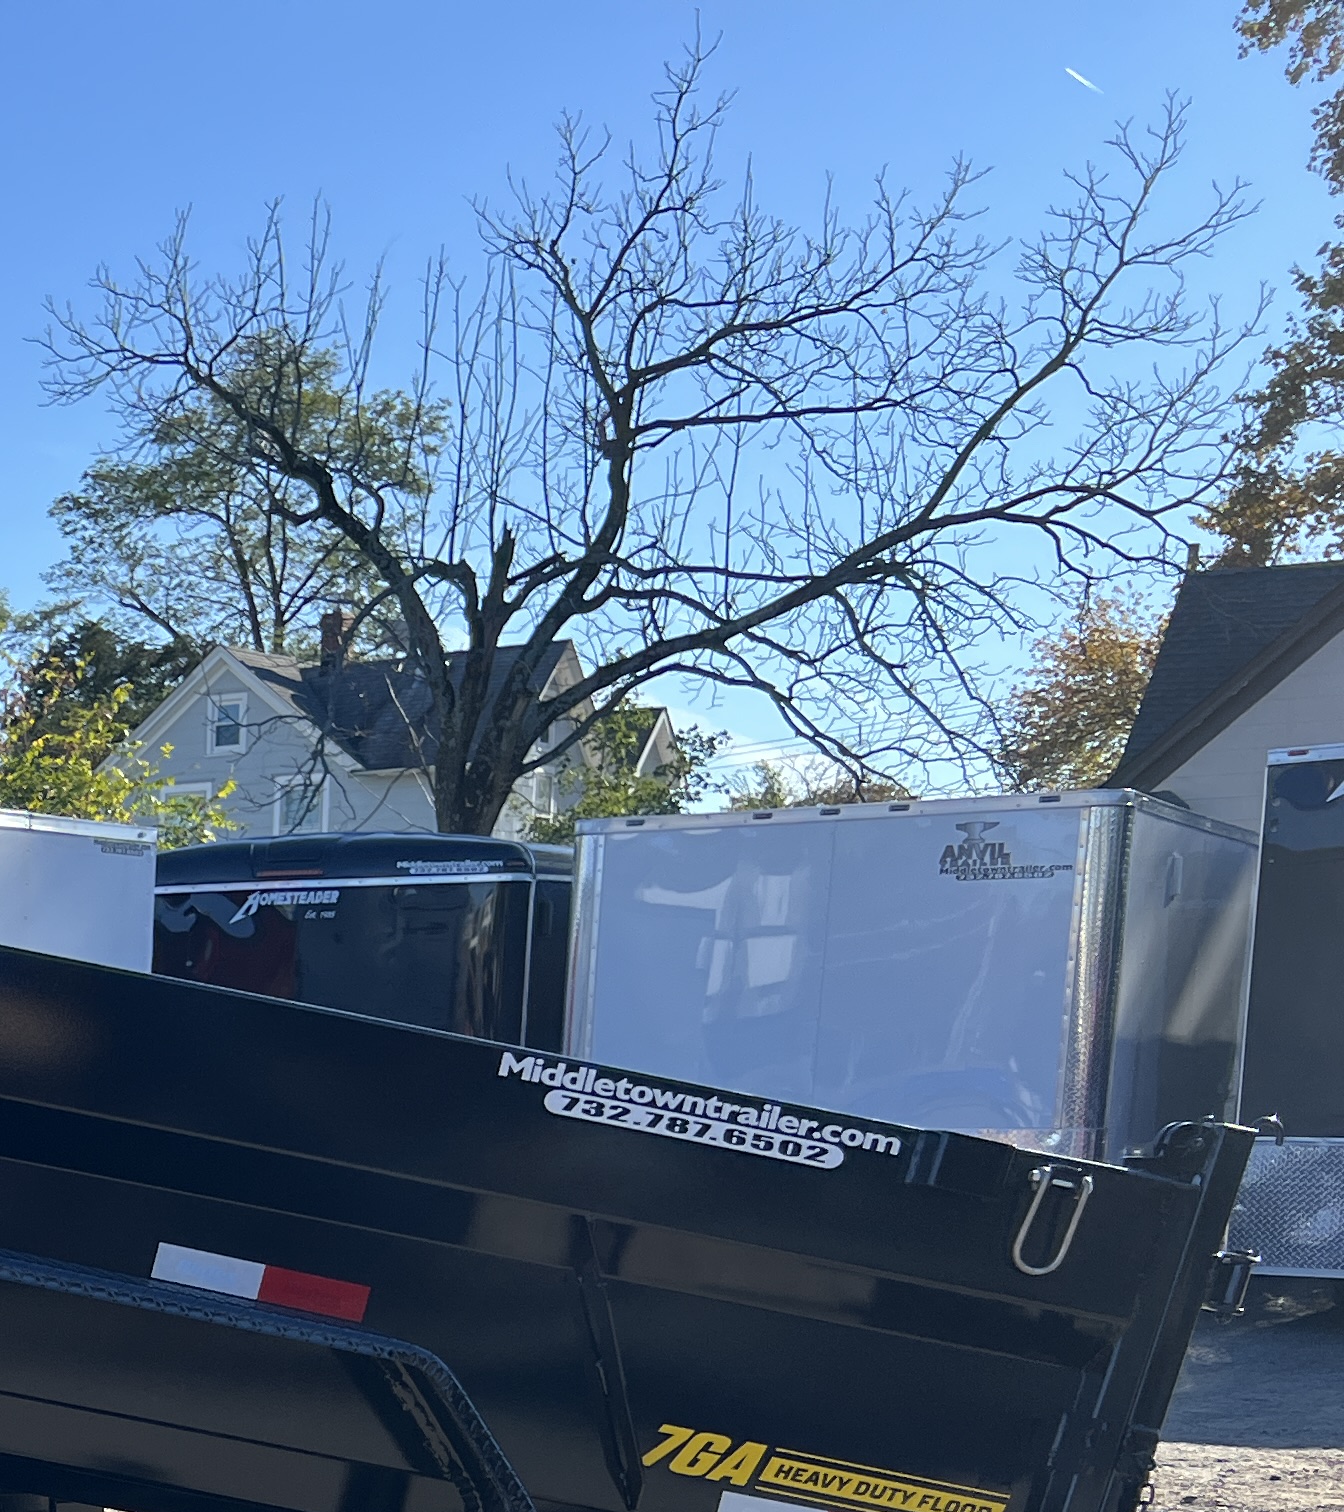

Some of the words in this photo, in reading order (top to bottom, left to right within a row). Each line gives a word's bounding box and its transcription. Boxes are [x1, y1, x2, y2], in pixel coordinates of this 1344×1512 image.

[939, 842, 1011, 861] ANVIL
[498, 1051, 902, 1156] Middletowntrailer.com
[559, 1094, 830, 1164] 732.787.6502
[641, 1423, 768, 1487] 7GA
[773, 1463, 855, 1492] HEAVY
[852, 1481, 918, 1507] DUTY
